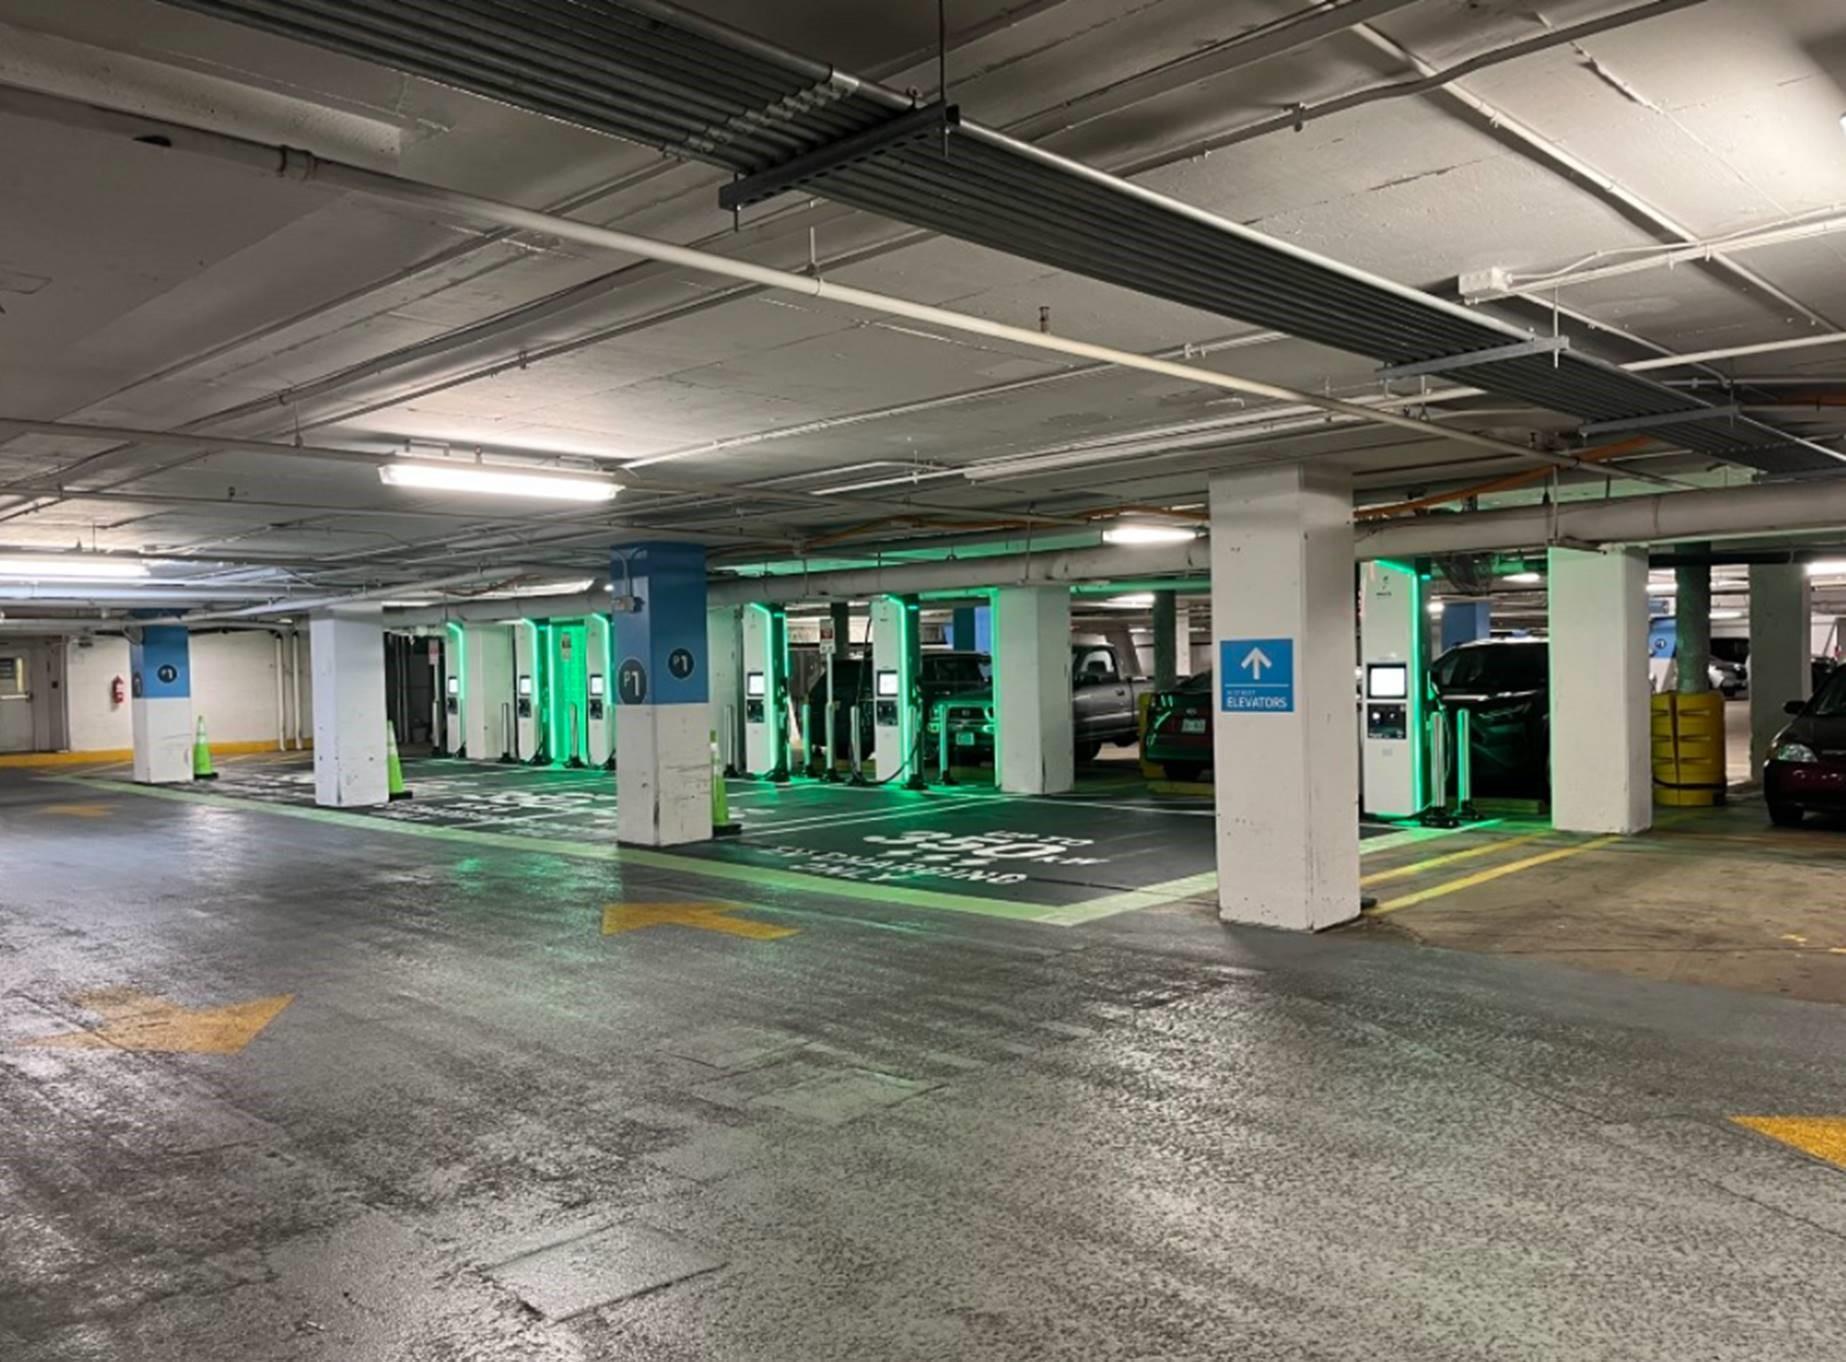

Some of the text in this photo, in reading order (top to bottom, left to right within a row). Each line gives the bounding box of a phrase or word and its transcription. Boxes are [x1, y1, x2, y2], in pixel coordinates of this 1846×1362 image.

[672, 654, 688, 673] P1
[623, 670, 640, 697] P1
[1227, 696, 1288, 708] ELEVATORS
